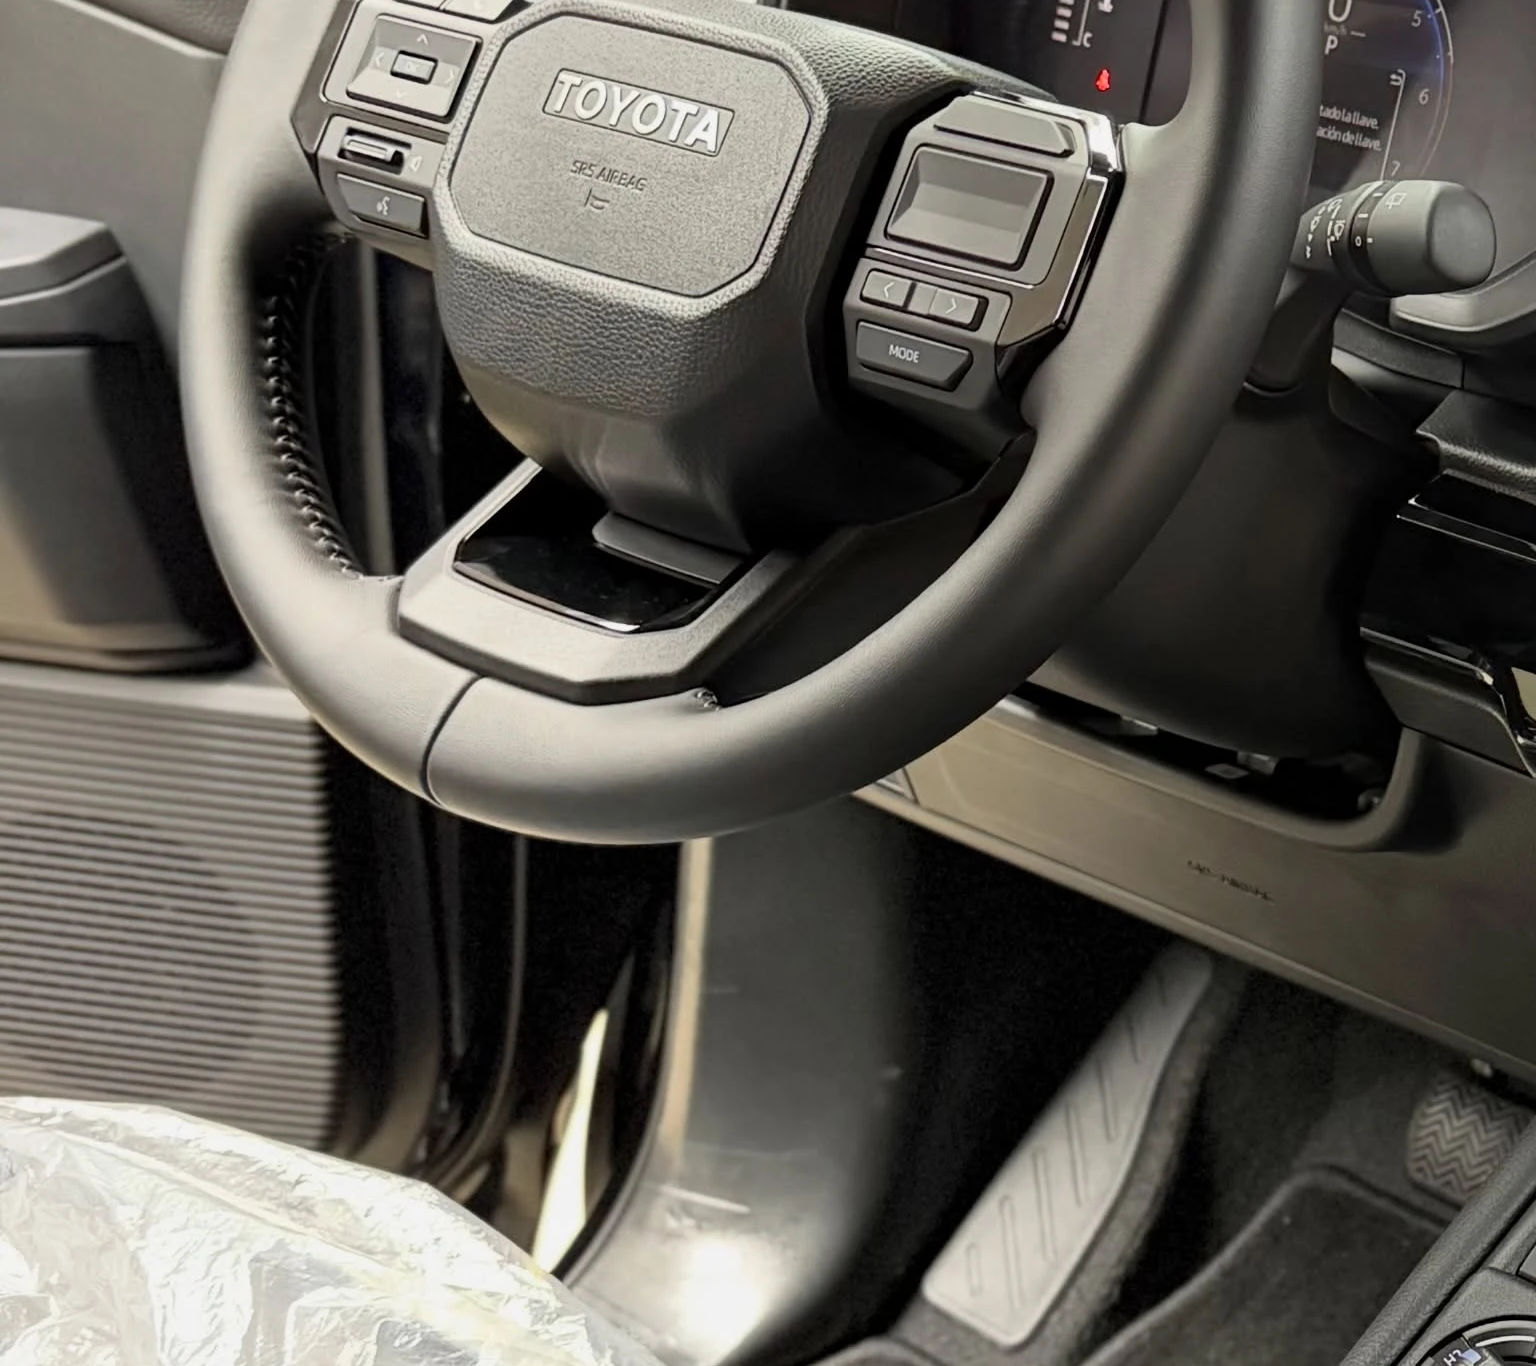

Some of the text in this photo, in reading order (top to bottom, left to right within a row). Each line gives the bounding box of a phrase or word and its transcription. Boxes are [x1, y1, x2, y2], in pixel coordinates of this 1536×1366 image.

[1411, 10, 1423, 27] 5
[1324, 35, 1338, 55] P
[1418, 88, 1430, 105] 6
[553, 72, 720, 154] TOYOTA
[570, 159, 648, 192] SRS AIRBAG
[889, 344, 920, 364] MODE
